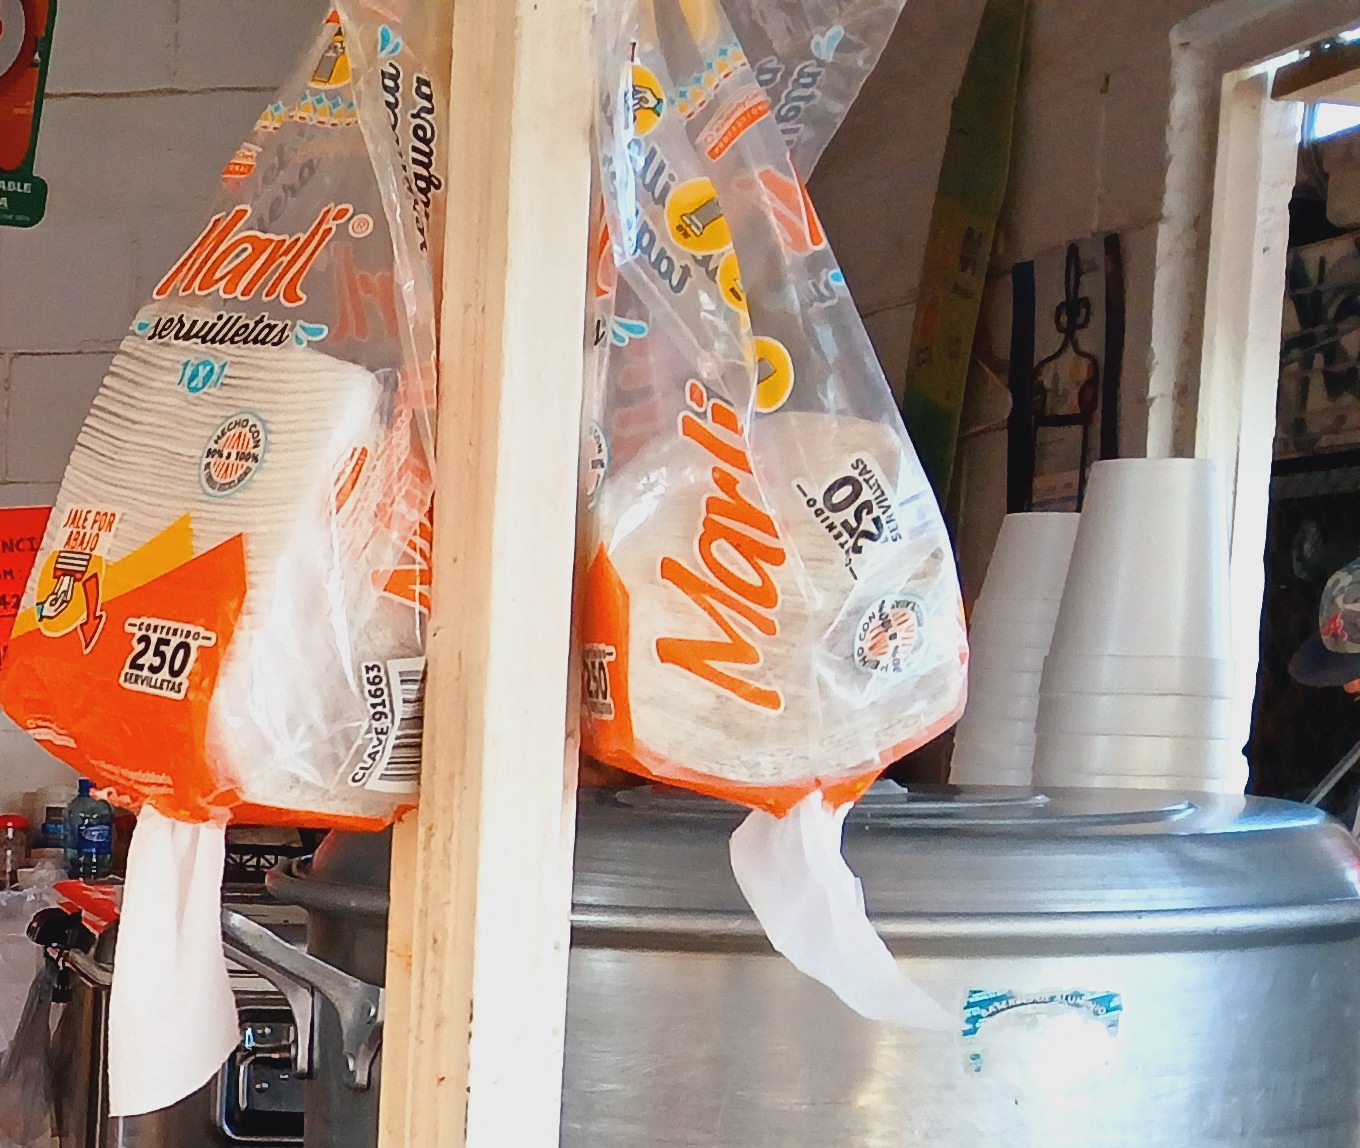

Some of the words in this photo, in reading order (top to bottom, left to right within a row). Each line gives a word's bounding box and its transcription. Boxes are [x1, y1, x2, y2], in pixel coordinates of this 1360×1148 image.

[148, 314, 290, 347] servilletas
[214, 419, 249, 445] HECHO
[249, 424, 261, 449] CON
[63, 508, 92, 529] JALE
[91, 511, 116, 532] POR
[822, 475, 884, 554] 250
[63, 530, 99, 552] ABAJO
[656, 380, 787, 711] Marli
[129, 634, 191, 678] 250
[124, 672, 183, 694] SERVILLETAS
[365, 664, 389, 721] 91663
[351, 726, 389, 783] CLAVE
